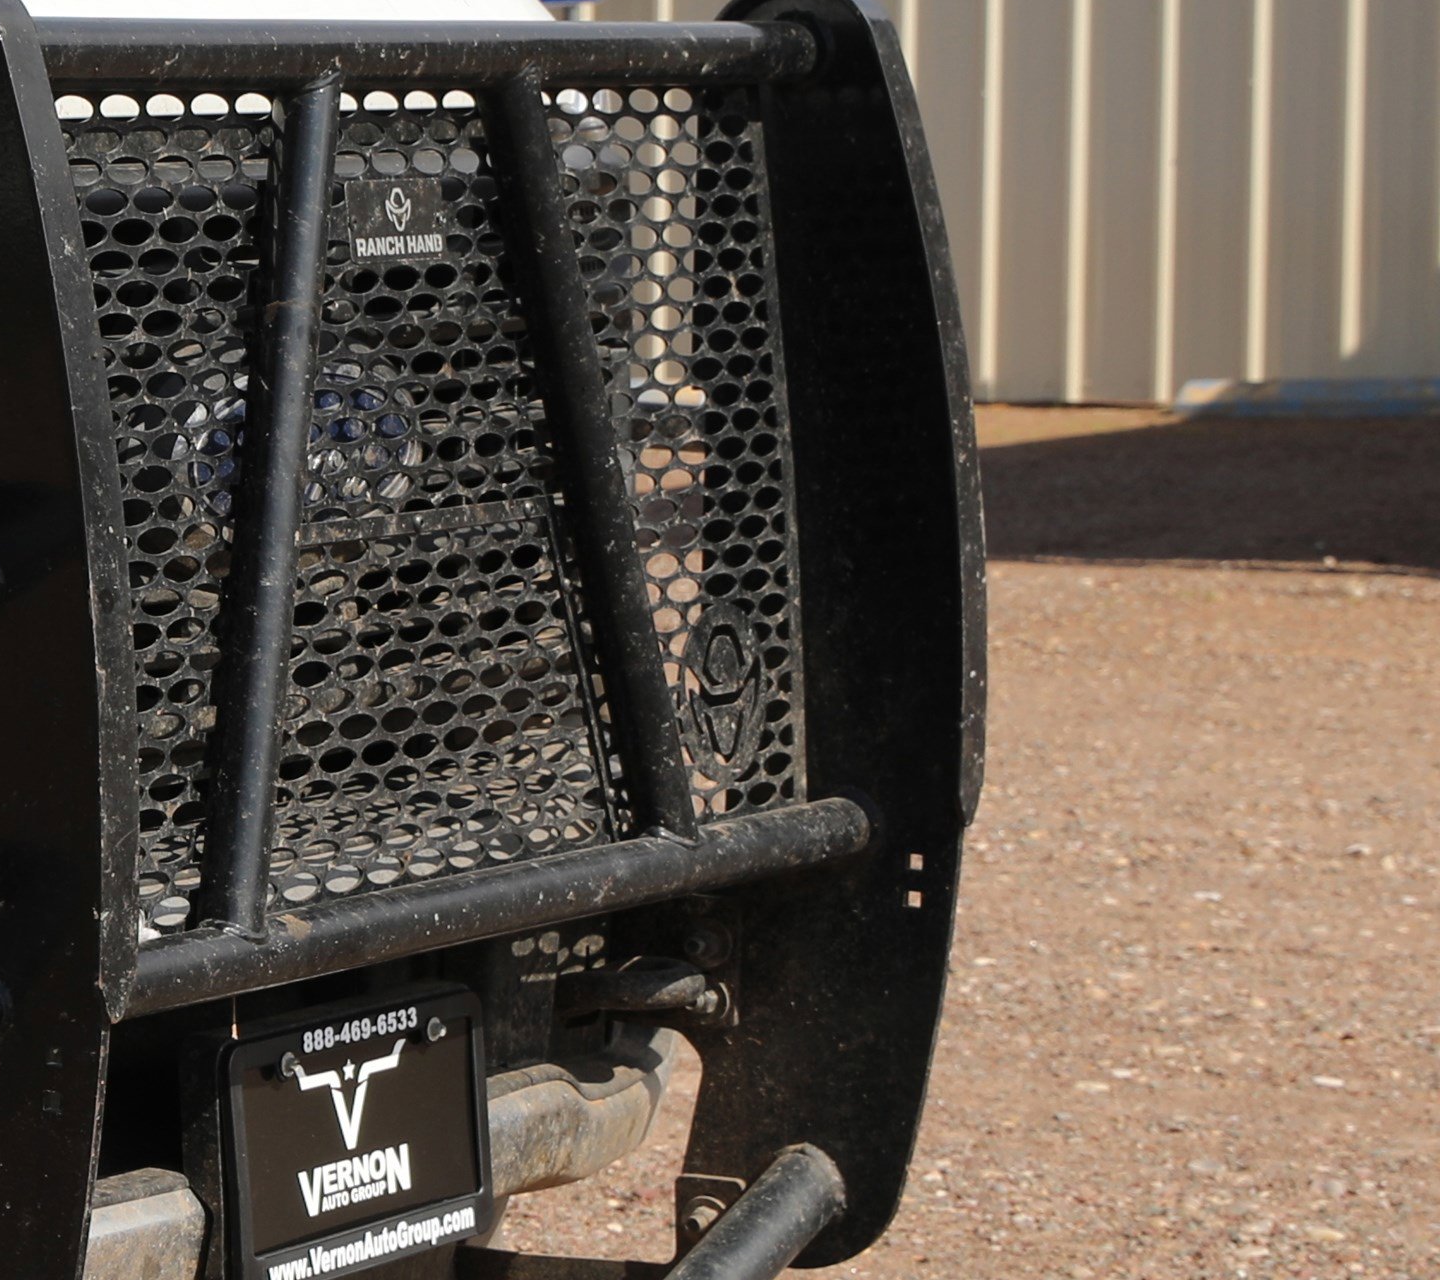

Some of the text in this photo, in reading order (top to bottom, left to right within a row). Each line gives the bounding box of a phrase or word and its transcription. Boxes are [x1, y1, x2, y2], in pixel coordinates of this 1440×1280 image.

[356, 233, 443, 257] RANCH HAND
[303, 1007, 418, 1054] 888-469-6533
[298, 1144, 411, 1217] VERNON
[322, 1181, 386, 1212] AUTO GROUP
